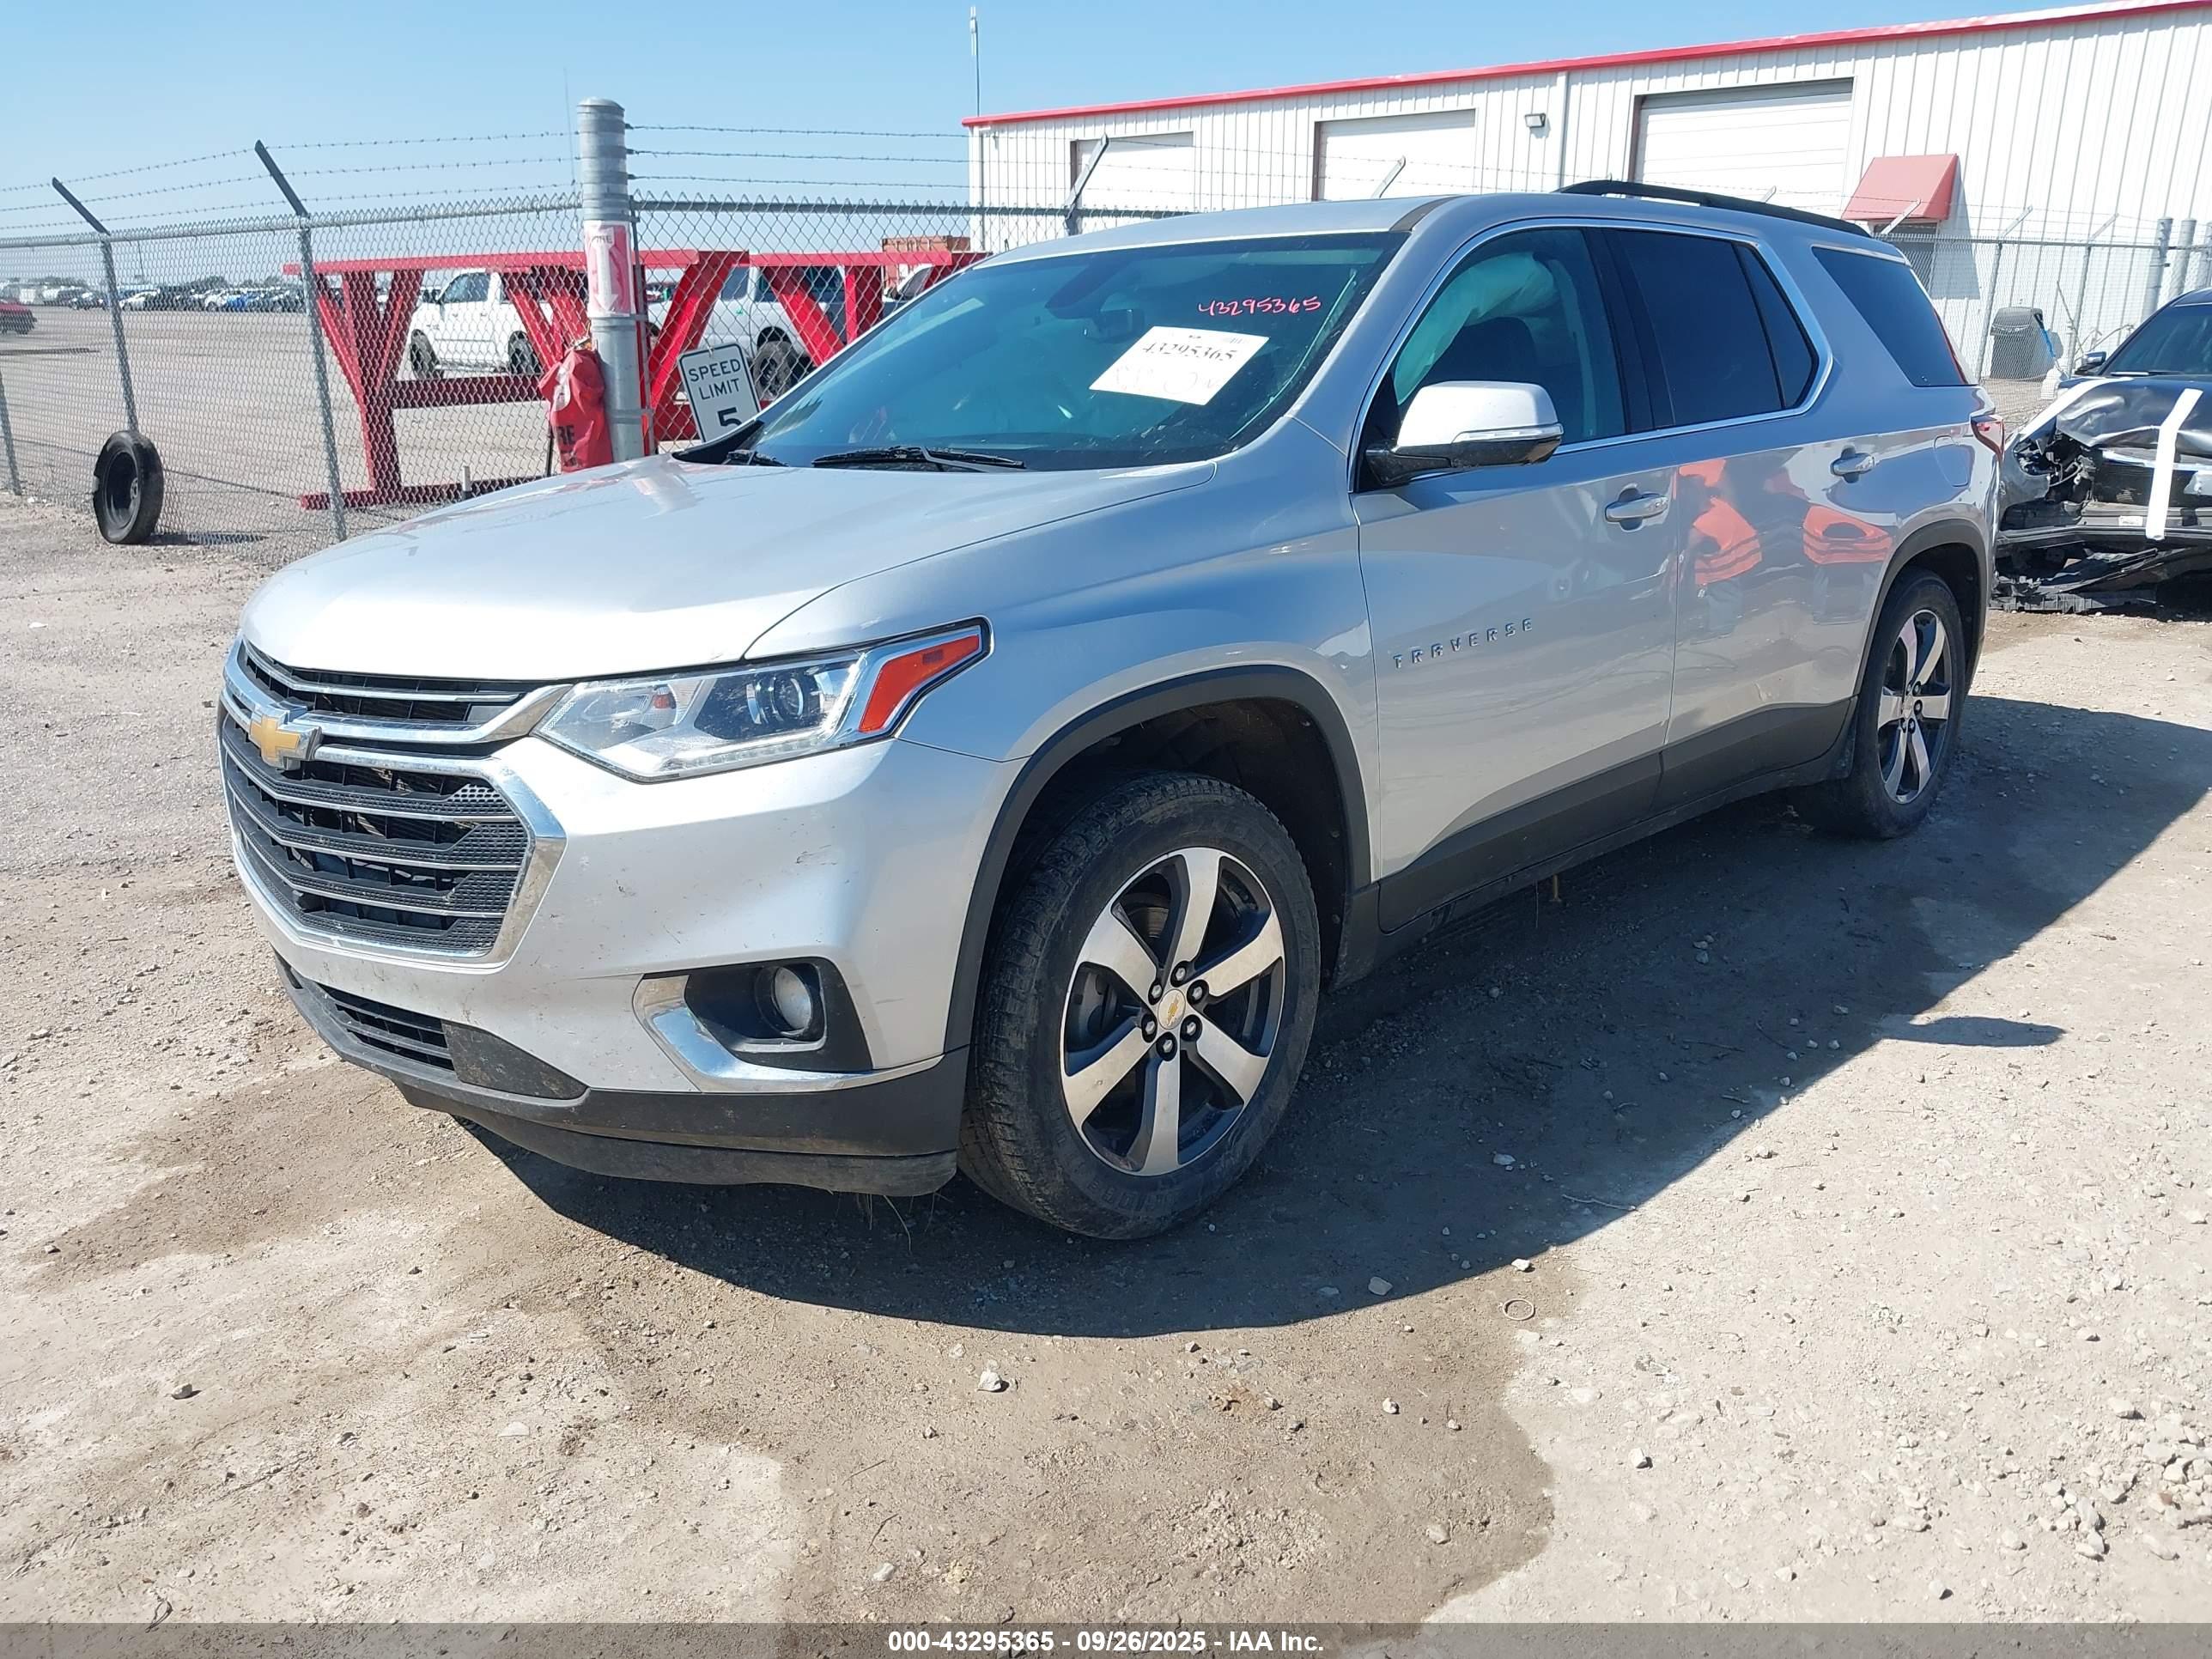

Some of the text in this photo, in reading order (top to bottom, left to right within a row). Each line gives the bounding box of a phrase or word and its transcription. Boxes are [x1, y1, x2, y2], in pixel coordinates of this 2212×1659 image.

[1198, 295, 1322, 316] 43295365
[689, 359, 741, 382] SPEED
[699, 378, 739, 400] LIMIT
[717, 406, 743, 427] 5
[1393, 617, 1533, 669] TRAVERSE
